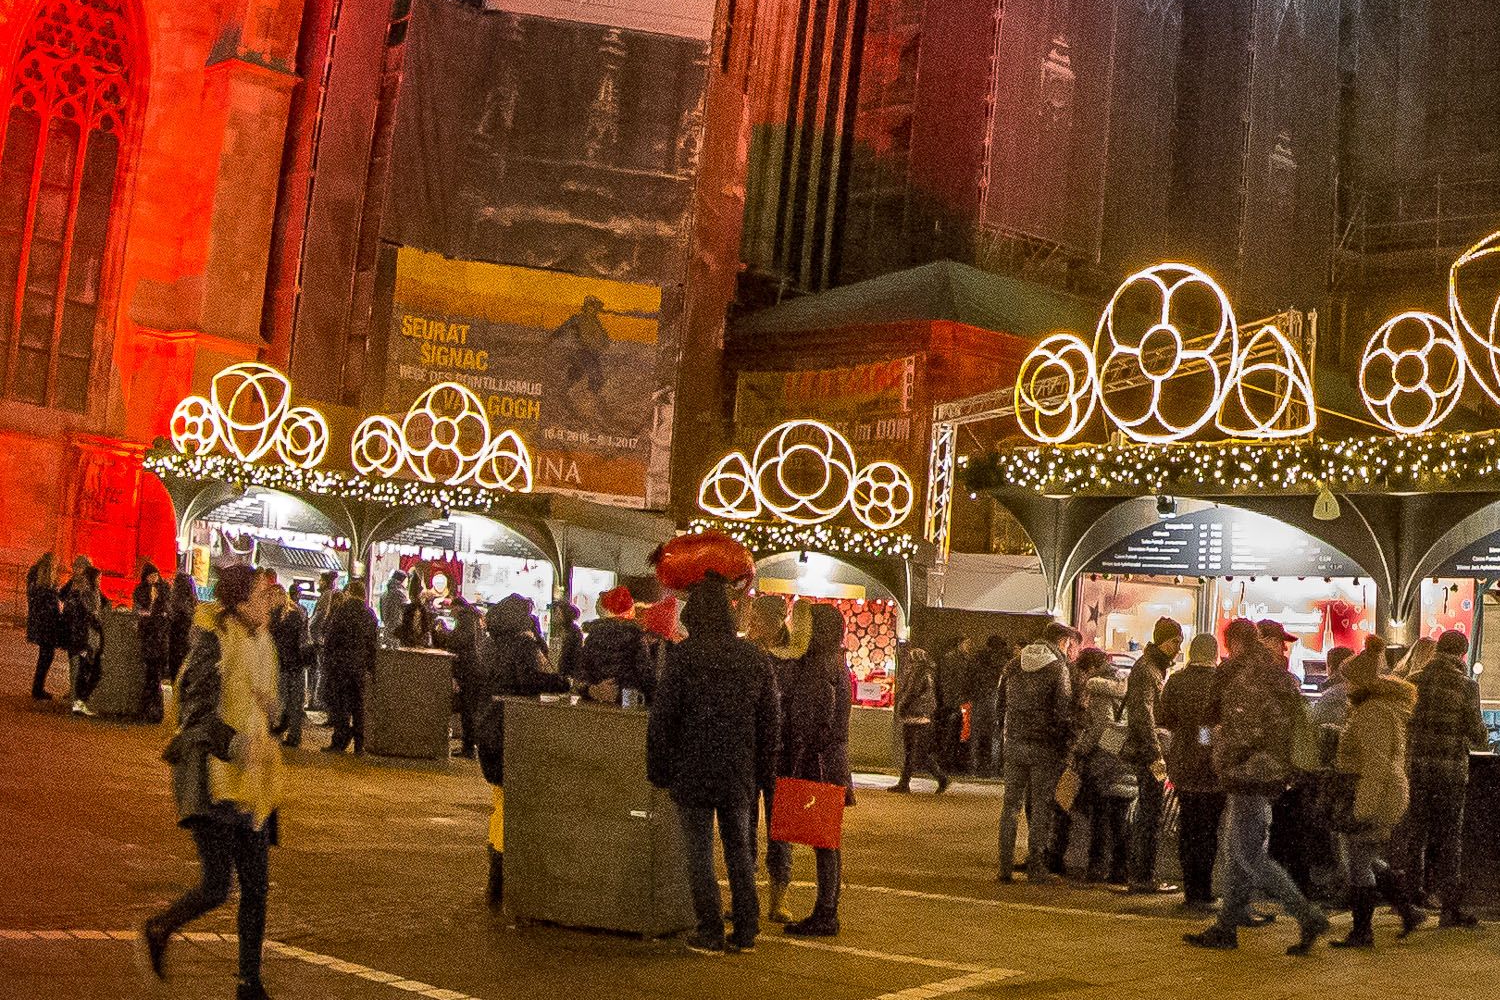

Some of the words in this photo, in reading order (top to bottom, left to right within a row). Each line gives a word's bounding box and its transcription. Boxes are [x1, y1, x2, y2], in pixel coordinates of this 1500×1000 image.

[402, 315, 470, 345] SEURAT
[420, 342, 488, 372] SIGNAC
[487, 394, 541, 421] GOGH
